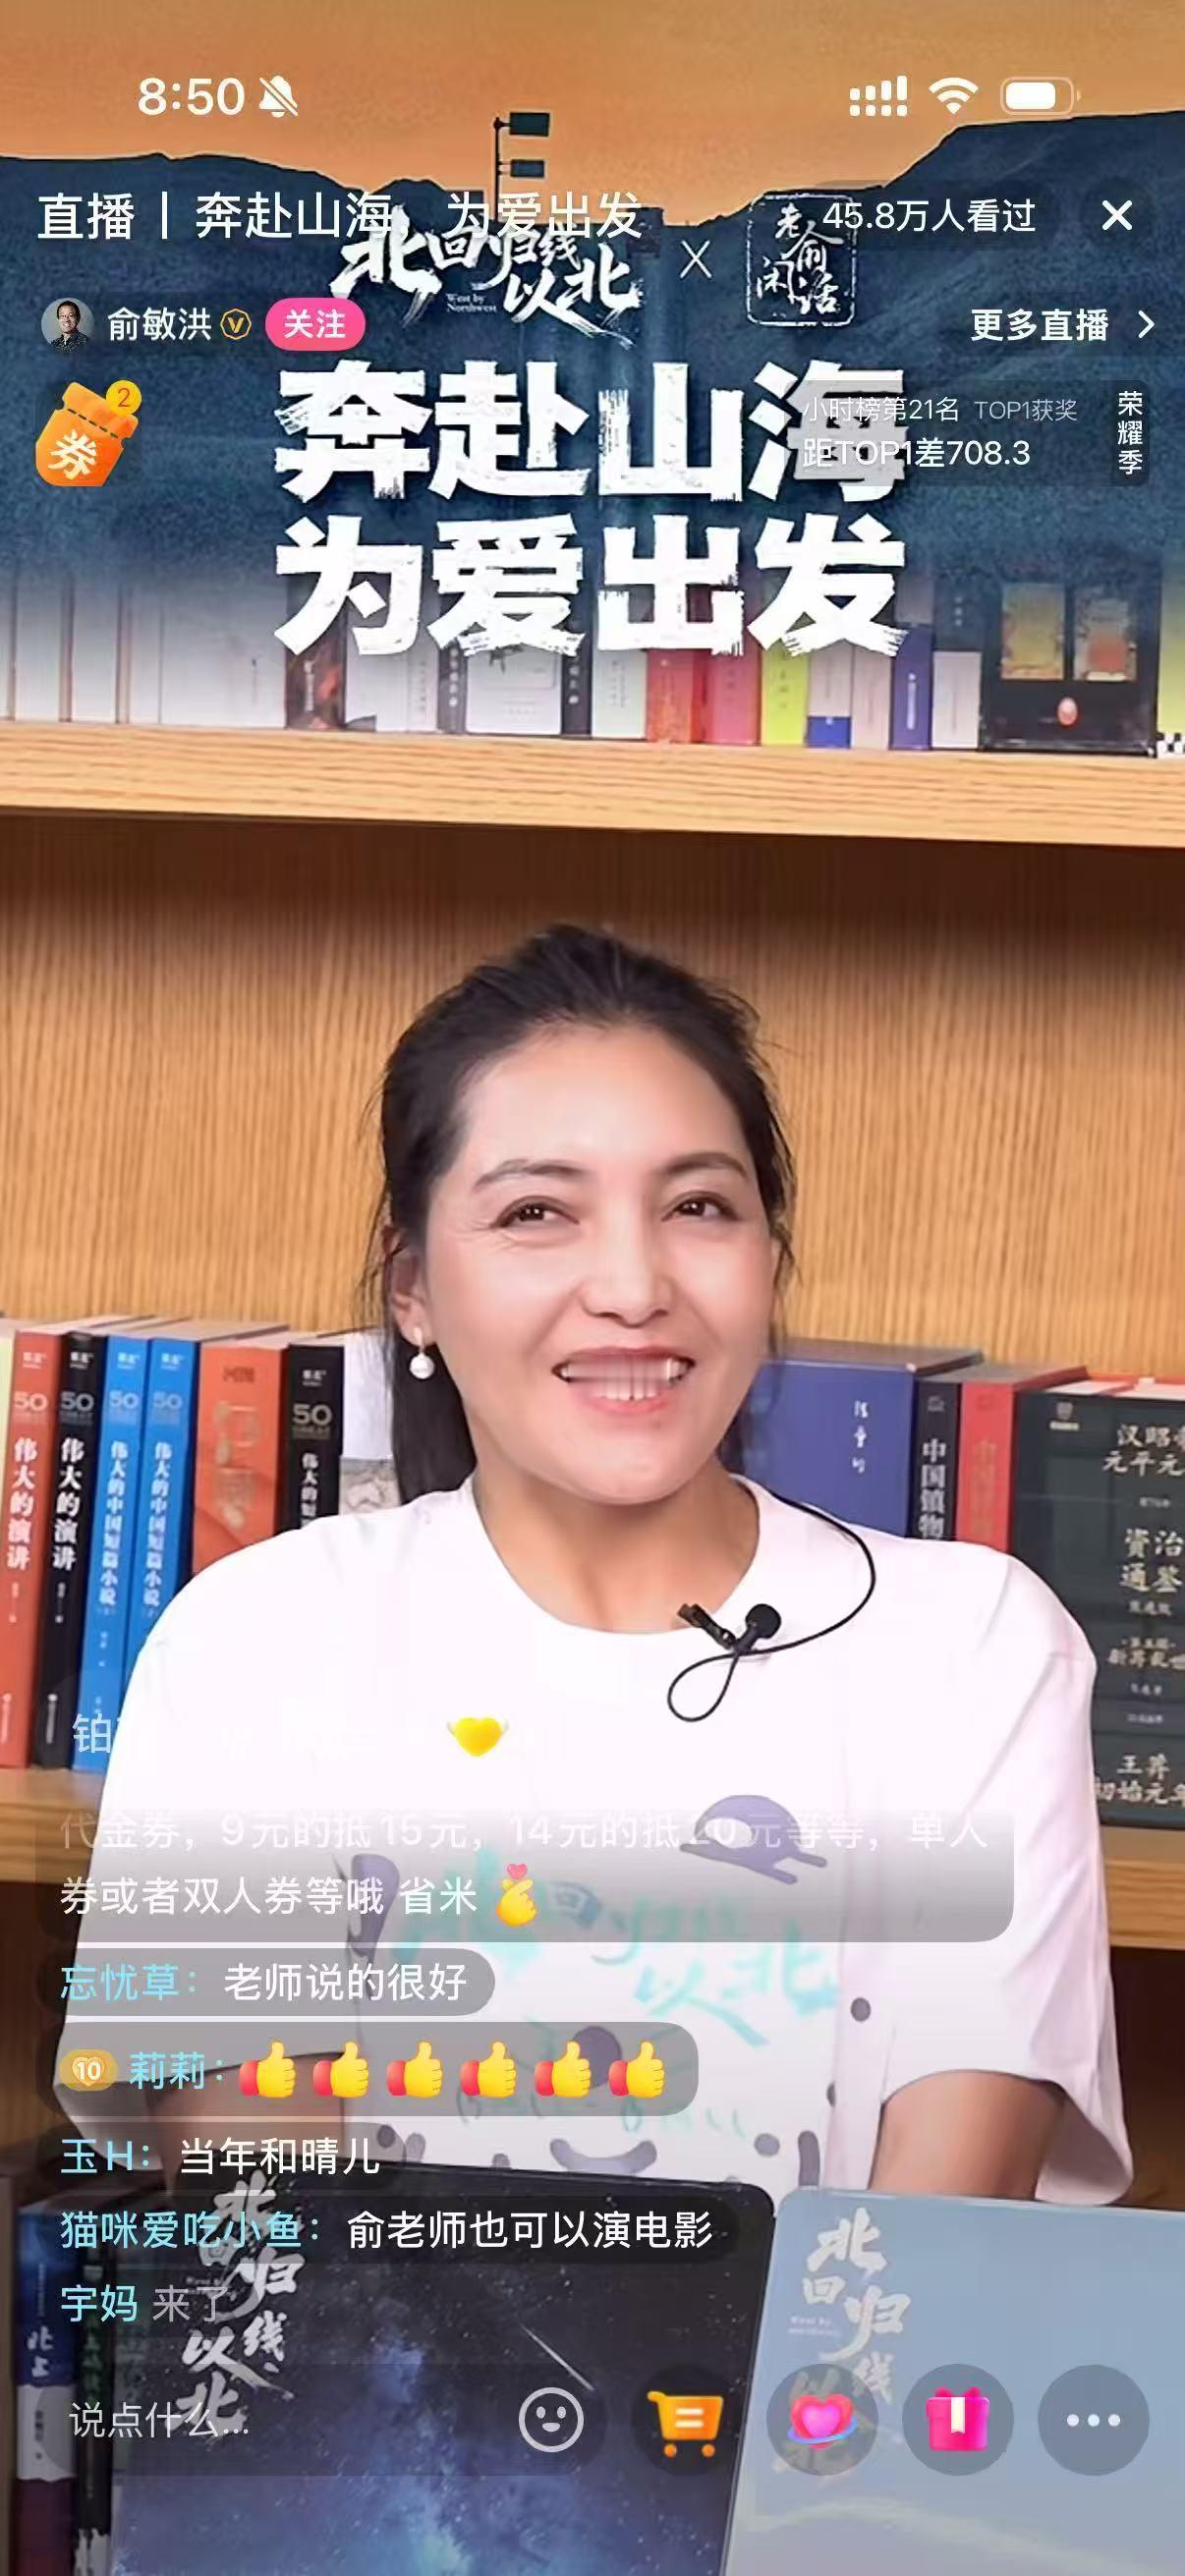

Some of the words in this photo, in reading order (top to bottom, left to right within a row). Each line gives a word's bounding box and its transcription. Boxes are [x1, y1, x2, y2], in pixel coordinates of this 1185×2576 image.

[61, 1391, 94, 1412] 50
[292, 1403, 333, 1426] 50
[52, 1437, 85, 1571] 伟大的演讲
